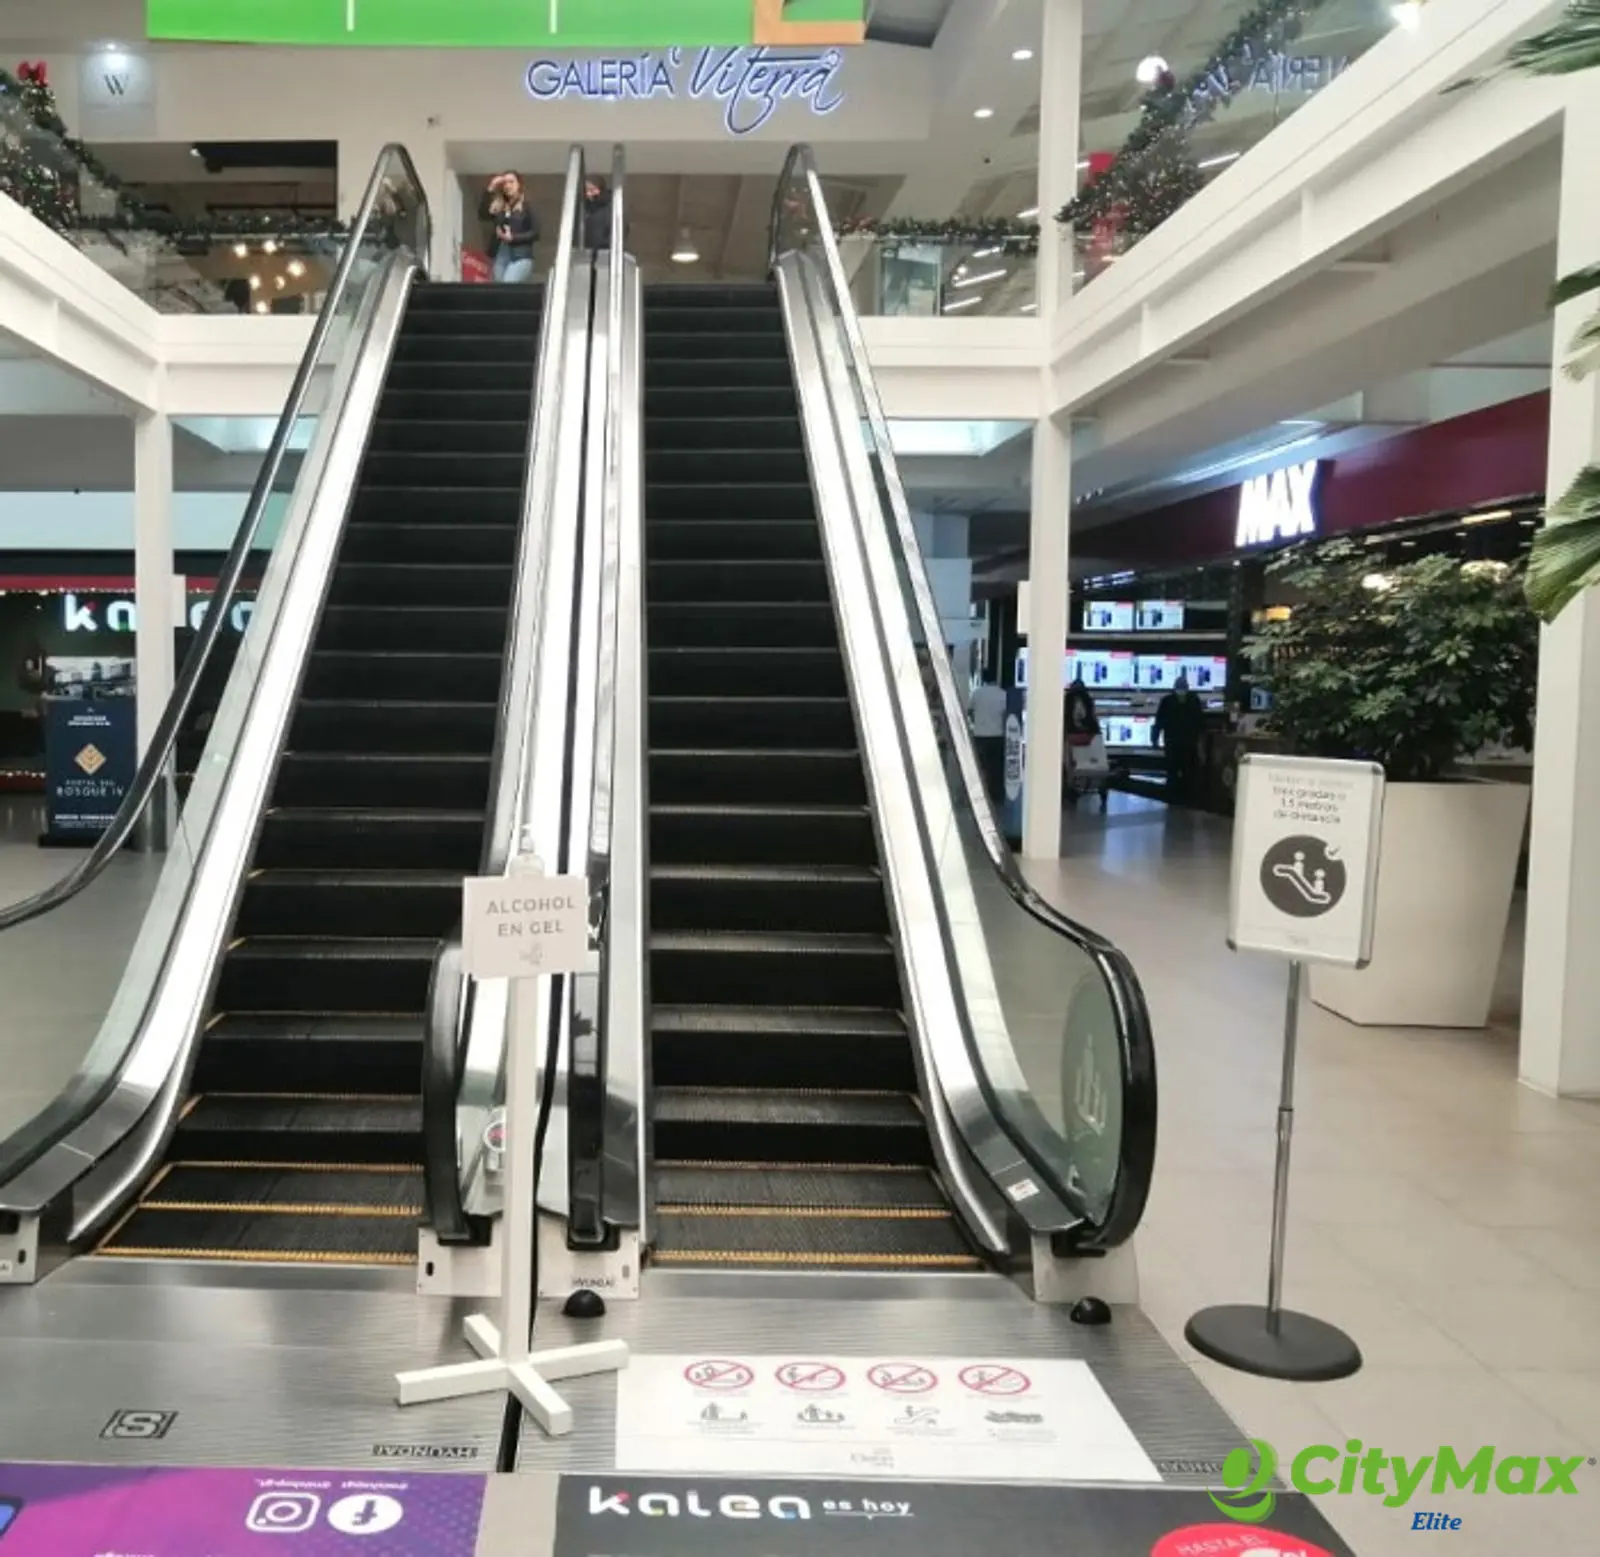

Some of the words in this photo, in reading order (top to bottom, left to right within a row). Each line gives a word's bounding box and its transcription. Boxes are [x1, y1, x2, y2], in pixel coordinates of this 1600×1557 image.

[526, 52, 675, 98] GALERÍA
[689, 46, 846, 134] Viterra
[1234, 458, 1318, 548] MAX
[485, 895, 576, 915] ALCOHOL
[498, 921, 523, 937] EN
[529, 919, 565, 935] GEL
[373, 1443, 479, 1459] HYUNDAI
[822, 1498, 852, 1511] es
[862, 1498, 911, 1516] hoy
